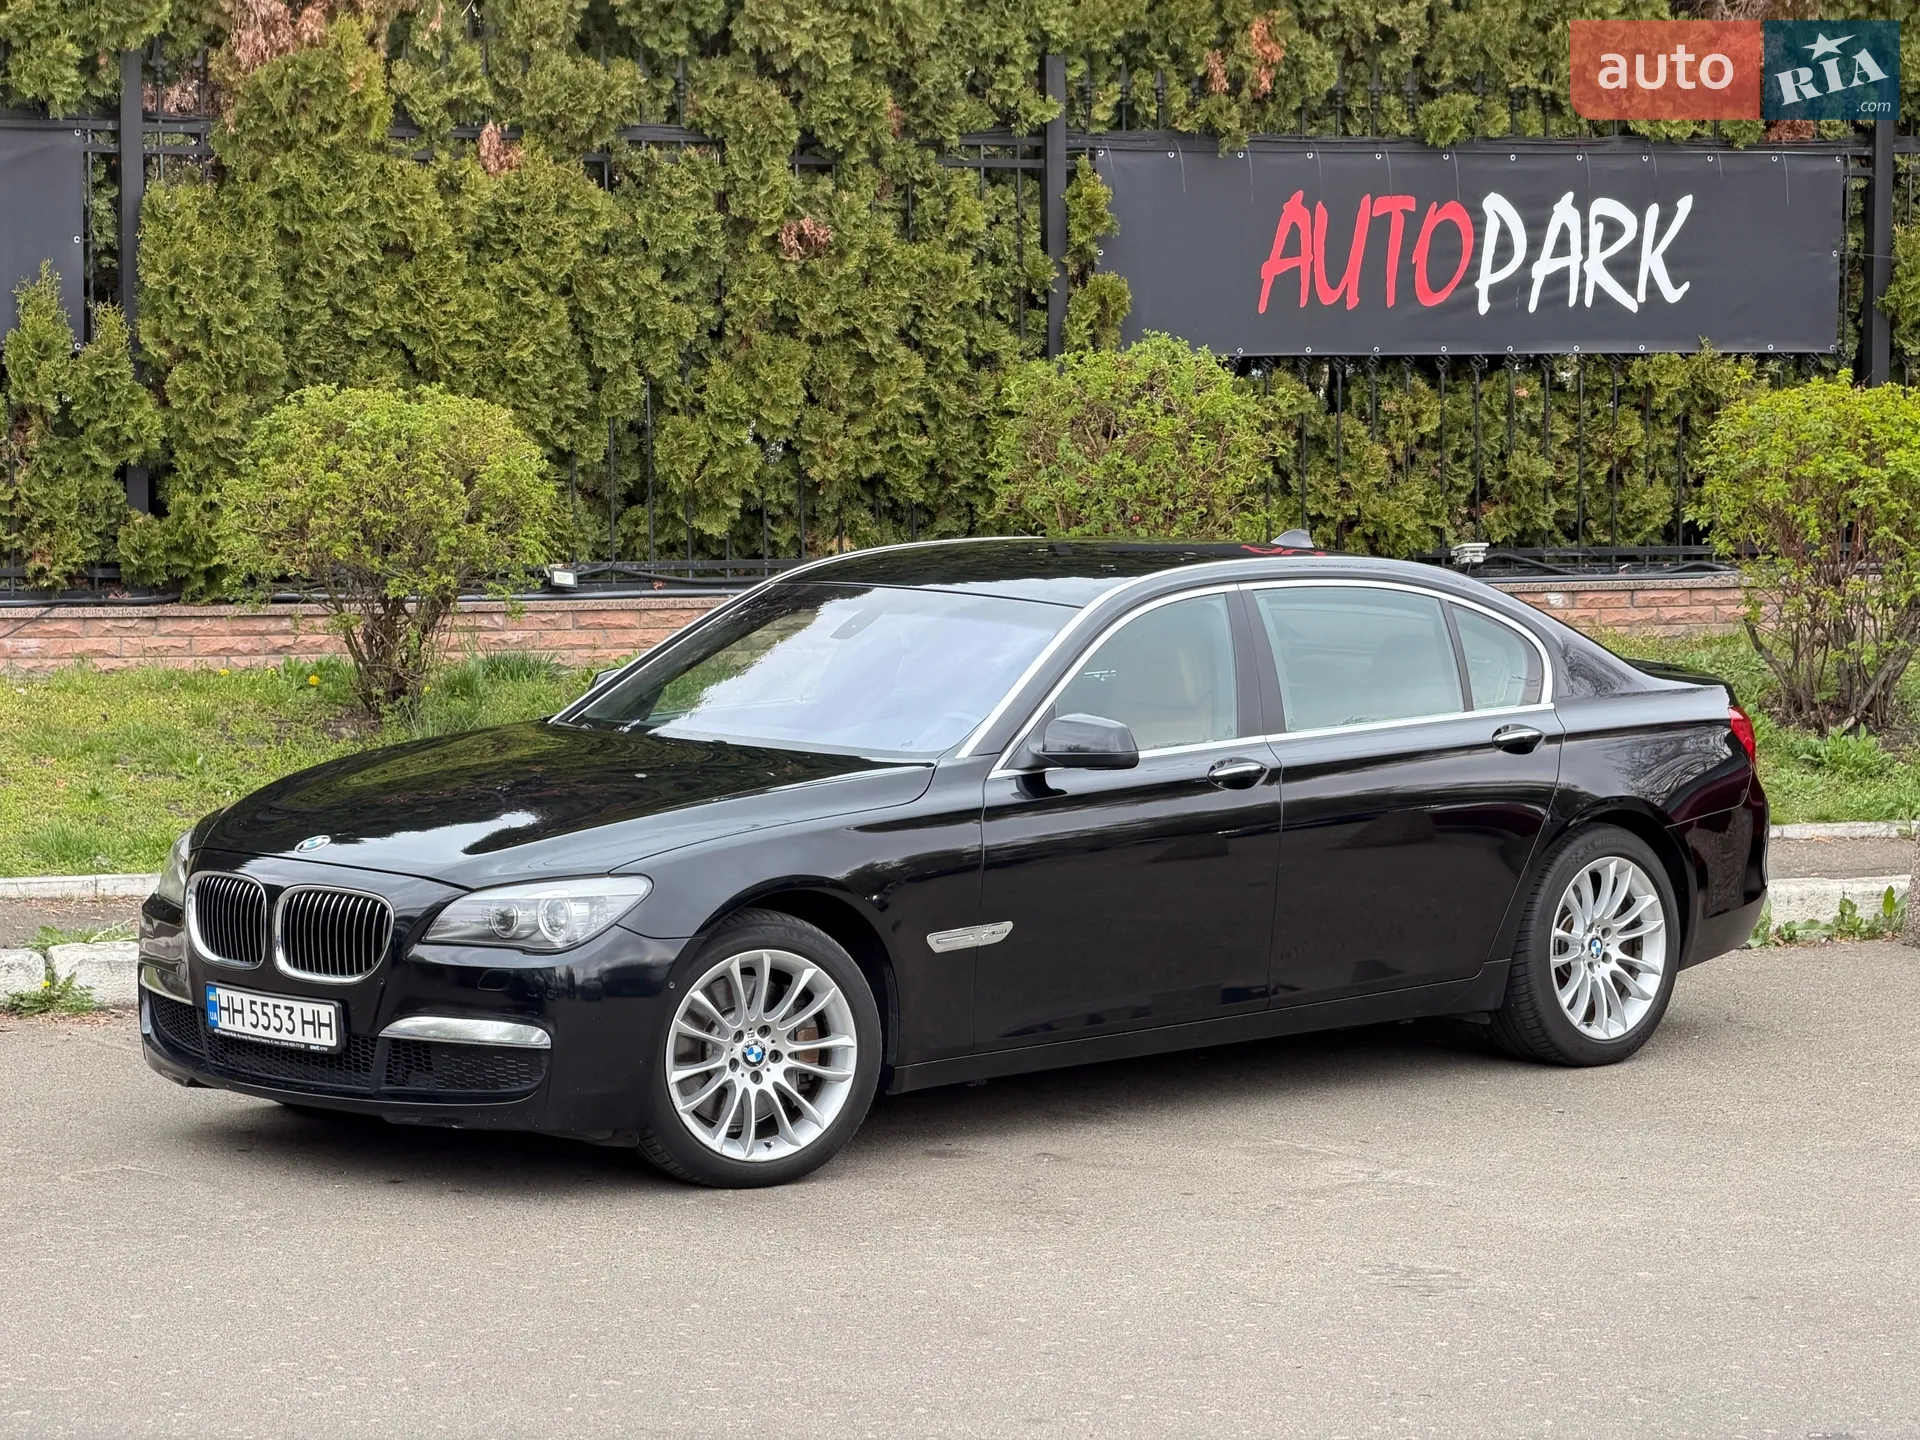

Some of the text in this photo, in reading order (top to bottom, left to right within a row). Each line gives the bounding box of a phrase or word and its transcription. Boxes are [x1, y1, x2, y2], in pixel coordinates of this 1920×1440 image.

[209, 1011, 218, 1021] UA
[218, 993, 246, 1027] HH
[249, 999, 296, 1035] 5553
[300, 1007, 334, 1041] HH
